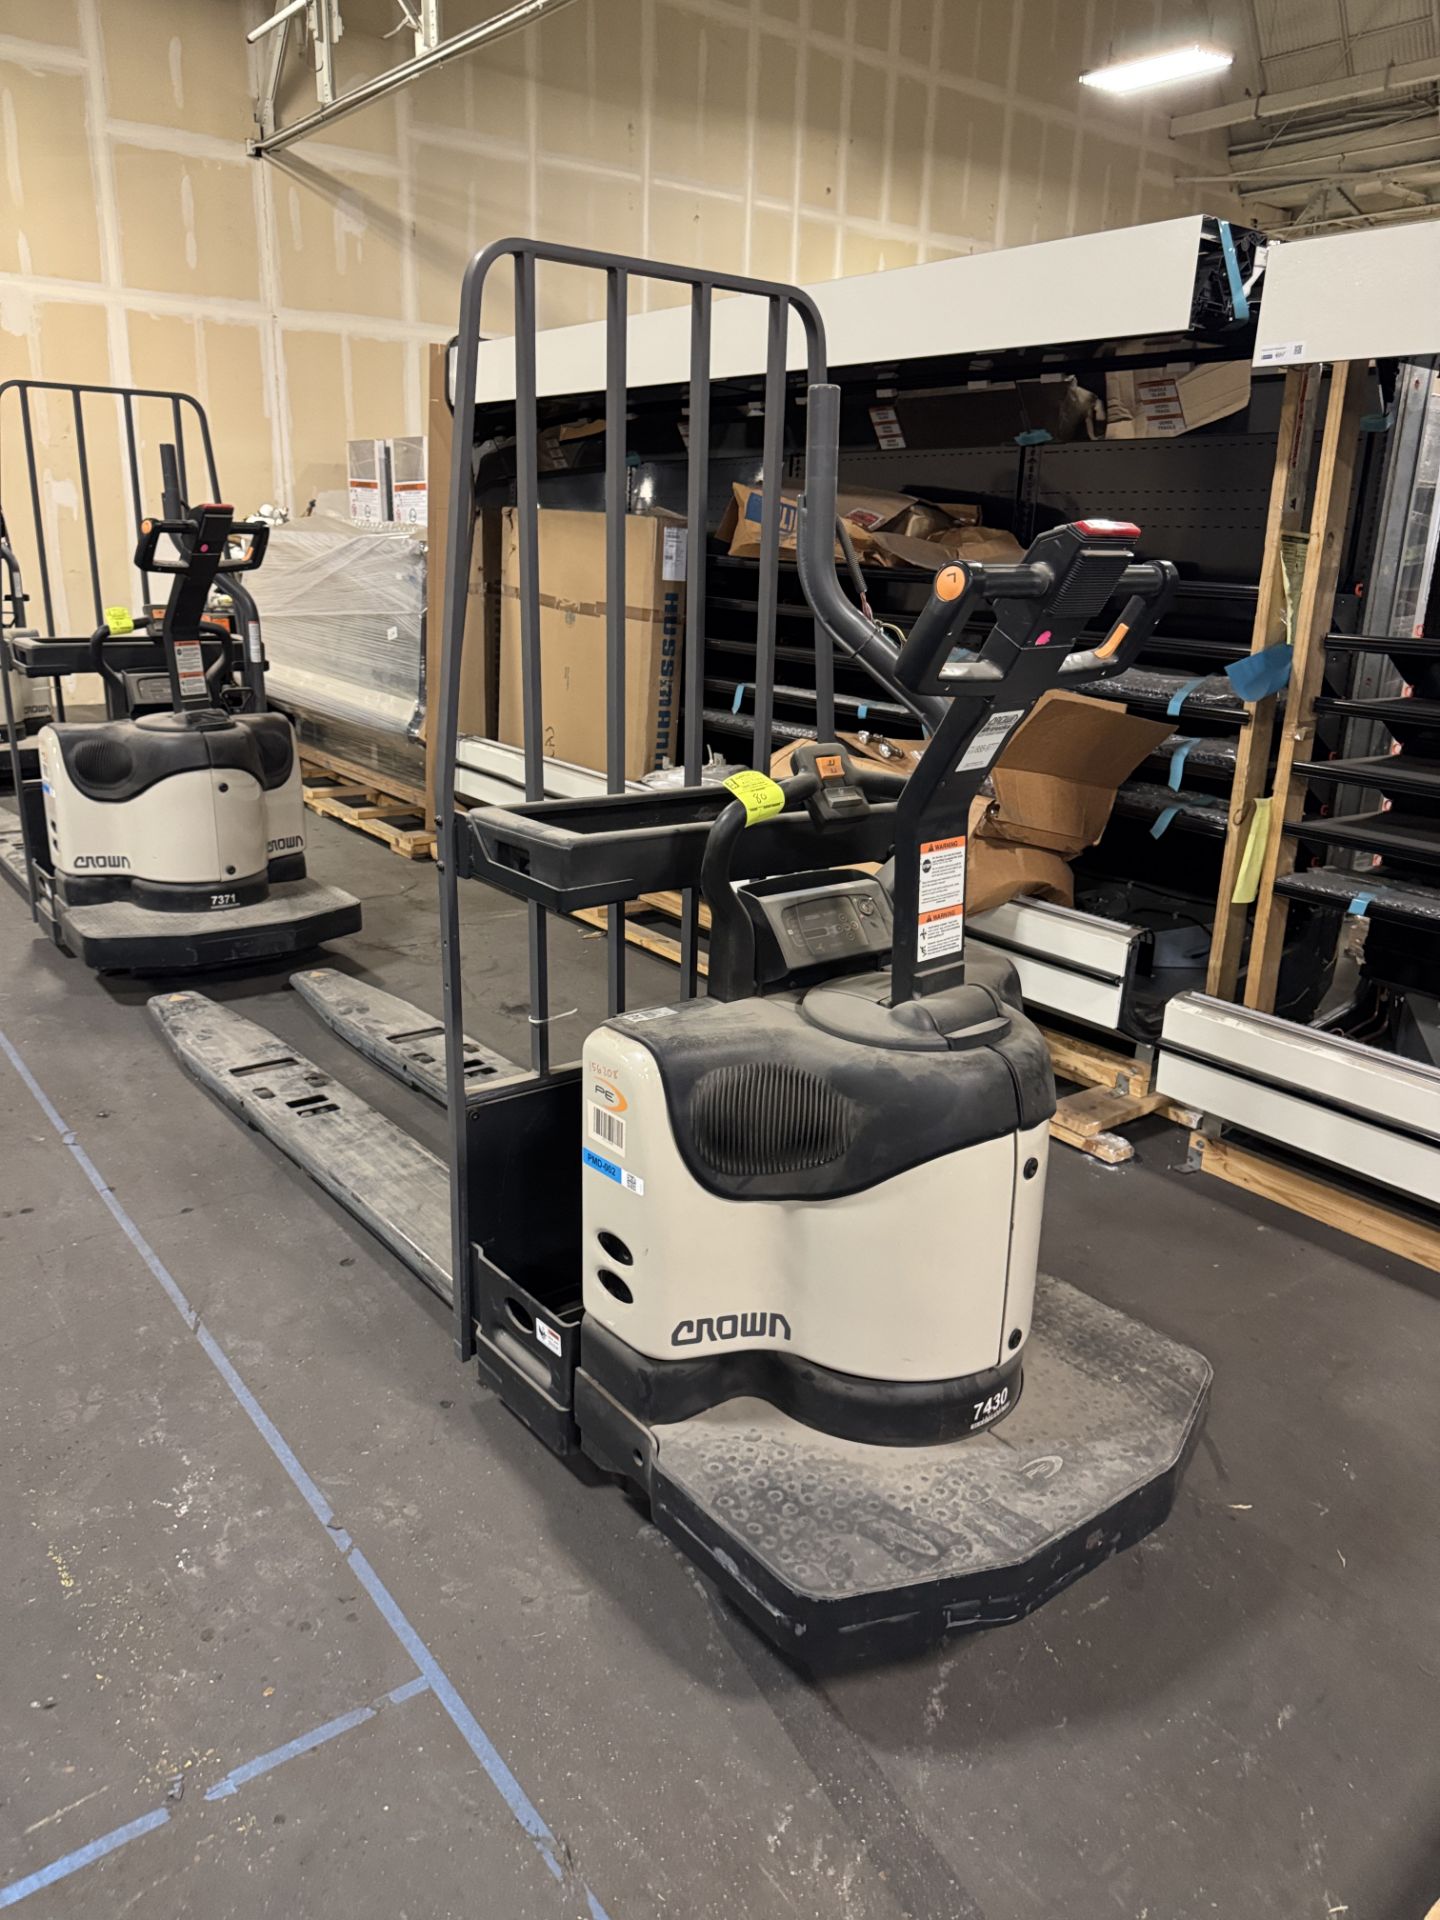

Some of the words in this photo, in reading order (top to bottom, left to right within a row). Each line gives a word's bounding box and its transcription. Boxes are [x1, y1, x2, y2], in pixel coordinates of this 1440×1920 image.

[73, 855, 131, 870] CROWN
[210, 893, 236, 905] 7371
[594, 1084, 615, 1104] PE
[671, 1311, 791, 1346] CROWN
[973, 1386, 1009, 1421] 7430
